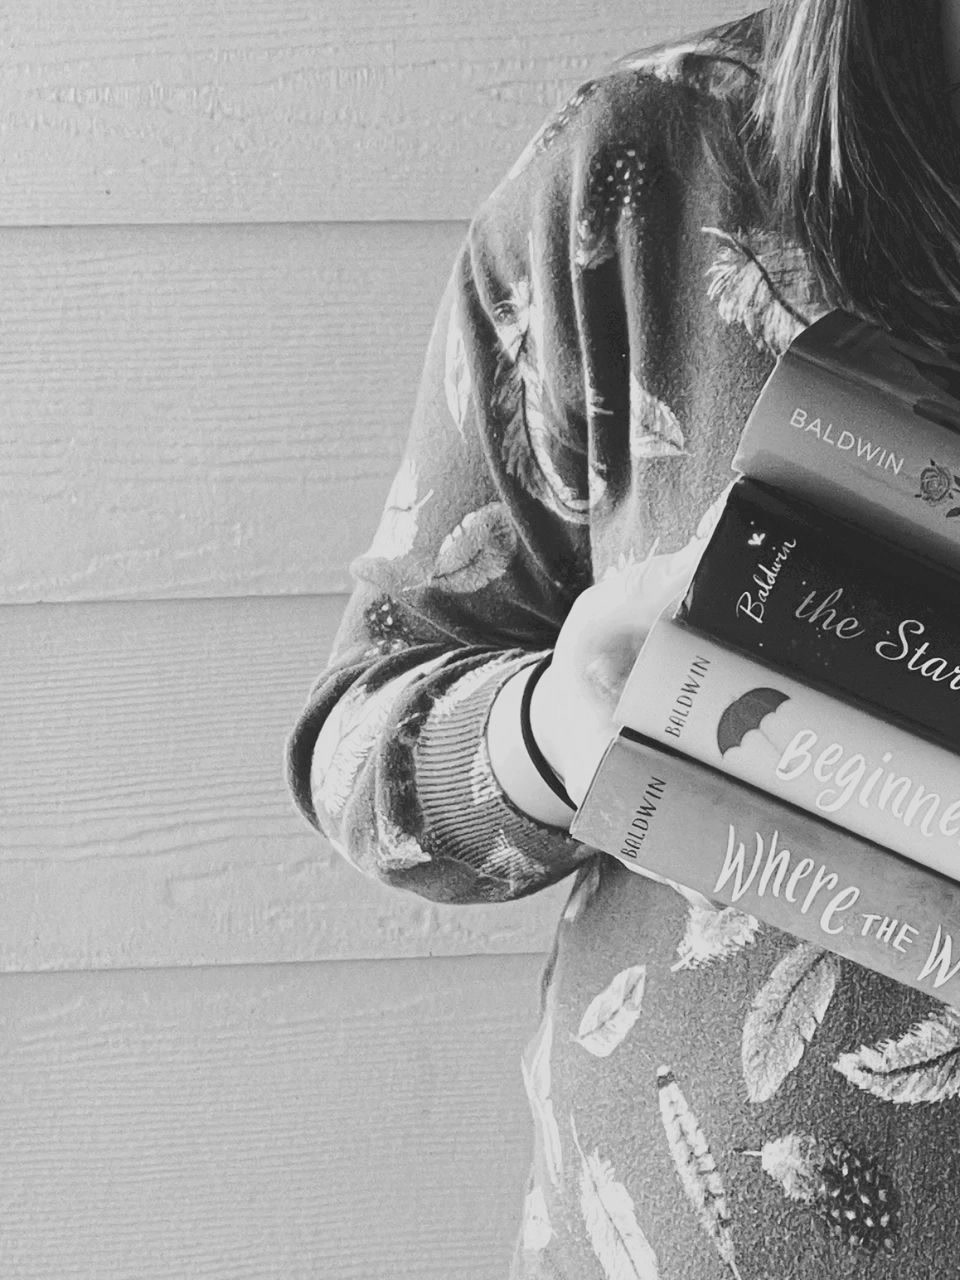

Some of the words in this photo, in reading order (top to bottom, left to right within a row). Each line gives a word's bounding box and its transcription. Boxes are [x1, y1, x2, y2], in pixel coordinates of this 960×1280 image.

[789, 408, 905, 475] BALDWIN
[736, 538, 798, 623] Baldwin
[795, 587, 865, 639] the
[664, 656, 711, 738] BALDWIN
[621, 777, 667, 858] BALDWIN
[713, 824, 860, 935] Where
[861, 913, 920, 953] THE
